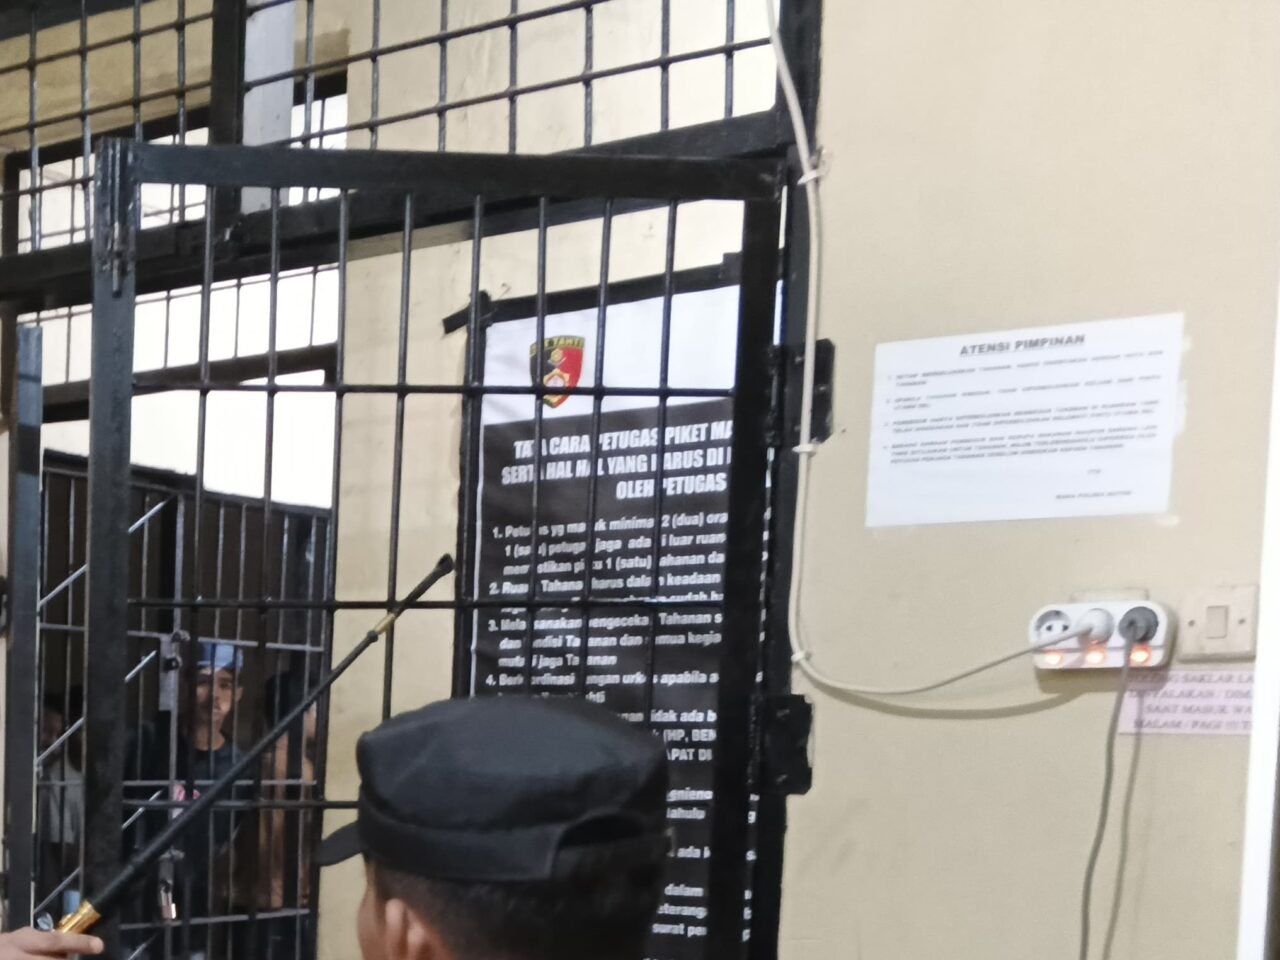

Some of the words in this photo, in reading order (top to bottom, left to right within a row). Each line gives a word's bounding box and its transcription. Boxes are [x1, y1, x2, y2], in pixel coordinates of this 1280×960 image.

[960, 342, 1010, 356] ATENSI
[1014, 334, 1085, 352] PIMPINAN
[549, 434, 591, 456] CARA
[598, 428, 658, 451] ETUGAS
[665, 423, 709, 446] PIKET
[546, 461, 574, 480] HAL
[608, 454, 648, 475] YANG
[706, 447, 724, 467] DI
[616, 478, 655, 501] OLEH
[493, 526, 504, 539] 1.
[551, 523, 564, 538] yg
[609, 515, 655, 530] minima
[661, 514, 670, 528] 2
[672, 511, 704, 529] (dua)
[595, 537, 622, 554] jaga
[628, 535, 651, 549] ada
[669, 534, 694, 547] luar
[615, 554, 652, 572] (satu)
[659, 552, 705, 567] ahanan
[489, 582, 500, 595] 2.
[666, 571, 721, 586] keadaan
[488, 619, 499, 632] 3.
[659, 612, 712, 626] Tahanan
[620, 633, 643, 646] dan
[538, 655, 563, 670] jaga
[565, 653, 617, 667] Taanan
[660, 670, 707, 687] apabila
[680, 709, 705, 722] ada
[677, 846, 701, 858] ada
[664, 883, 704, 897] dalam
